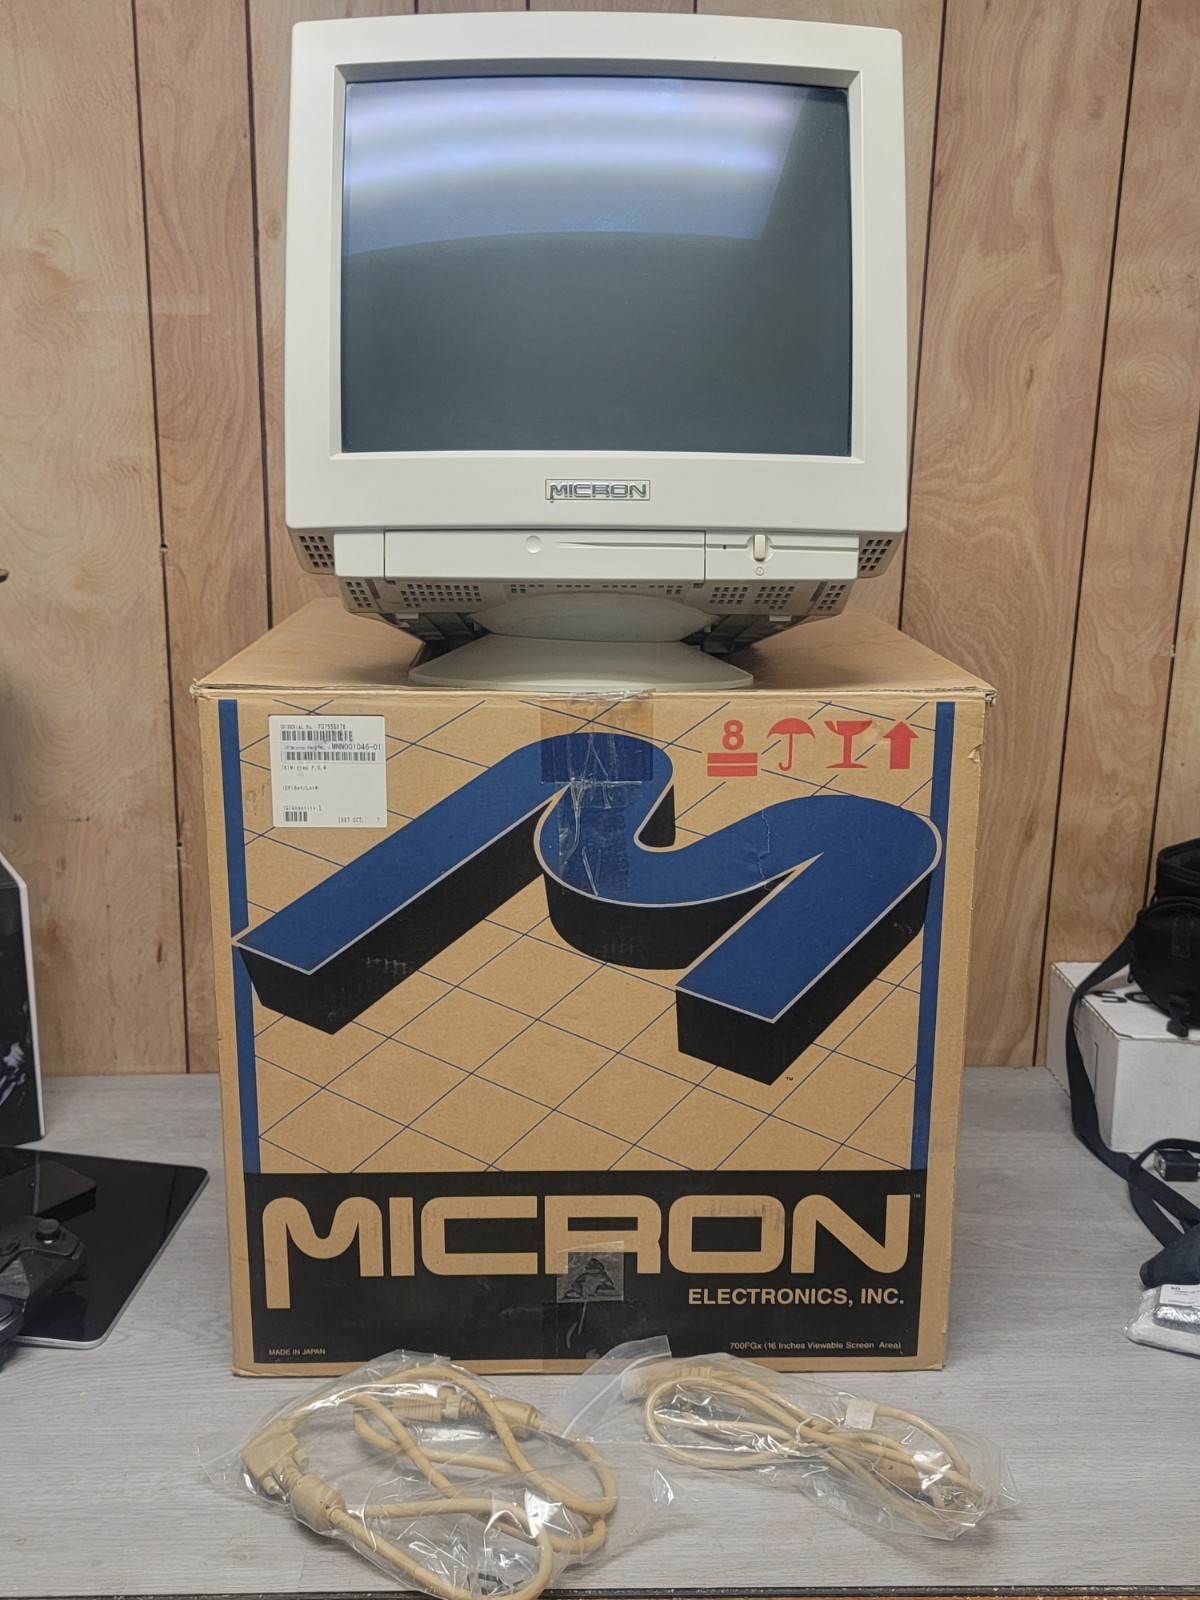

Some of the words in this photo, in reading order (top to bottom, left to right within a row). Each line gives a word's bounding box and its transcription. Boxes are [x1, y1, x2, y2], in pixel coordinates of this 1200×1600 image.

[549, 482, 647, 503] MICRON
[721, 719, 745, 751] 8
[262, 1194, 911, 1309] MICRON
[687, 1287, 854, 1307] ELECTRONICS,
[860, 1287, 905, 1304] INC.
[268, 1348, 290, 1356] MADE
[292, 1348, 301, 1356] IN
[301, 1347, 326, 1356] JAPAN
[729, 1341, 762, 1350] 700FGx
[764, 1341, 777, 1351] (16
[778, 1341, 806, 1350] Inches
[807, 1341, 844, 1350] Viewable
[845, 1341, 875, 1350] Screen
[878, 1341, 902, 1351] Area)
